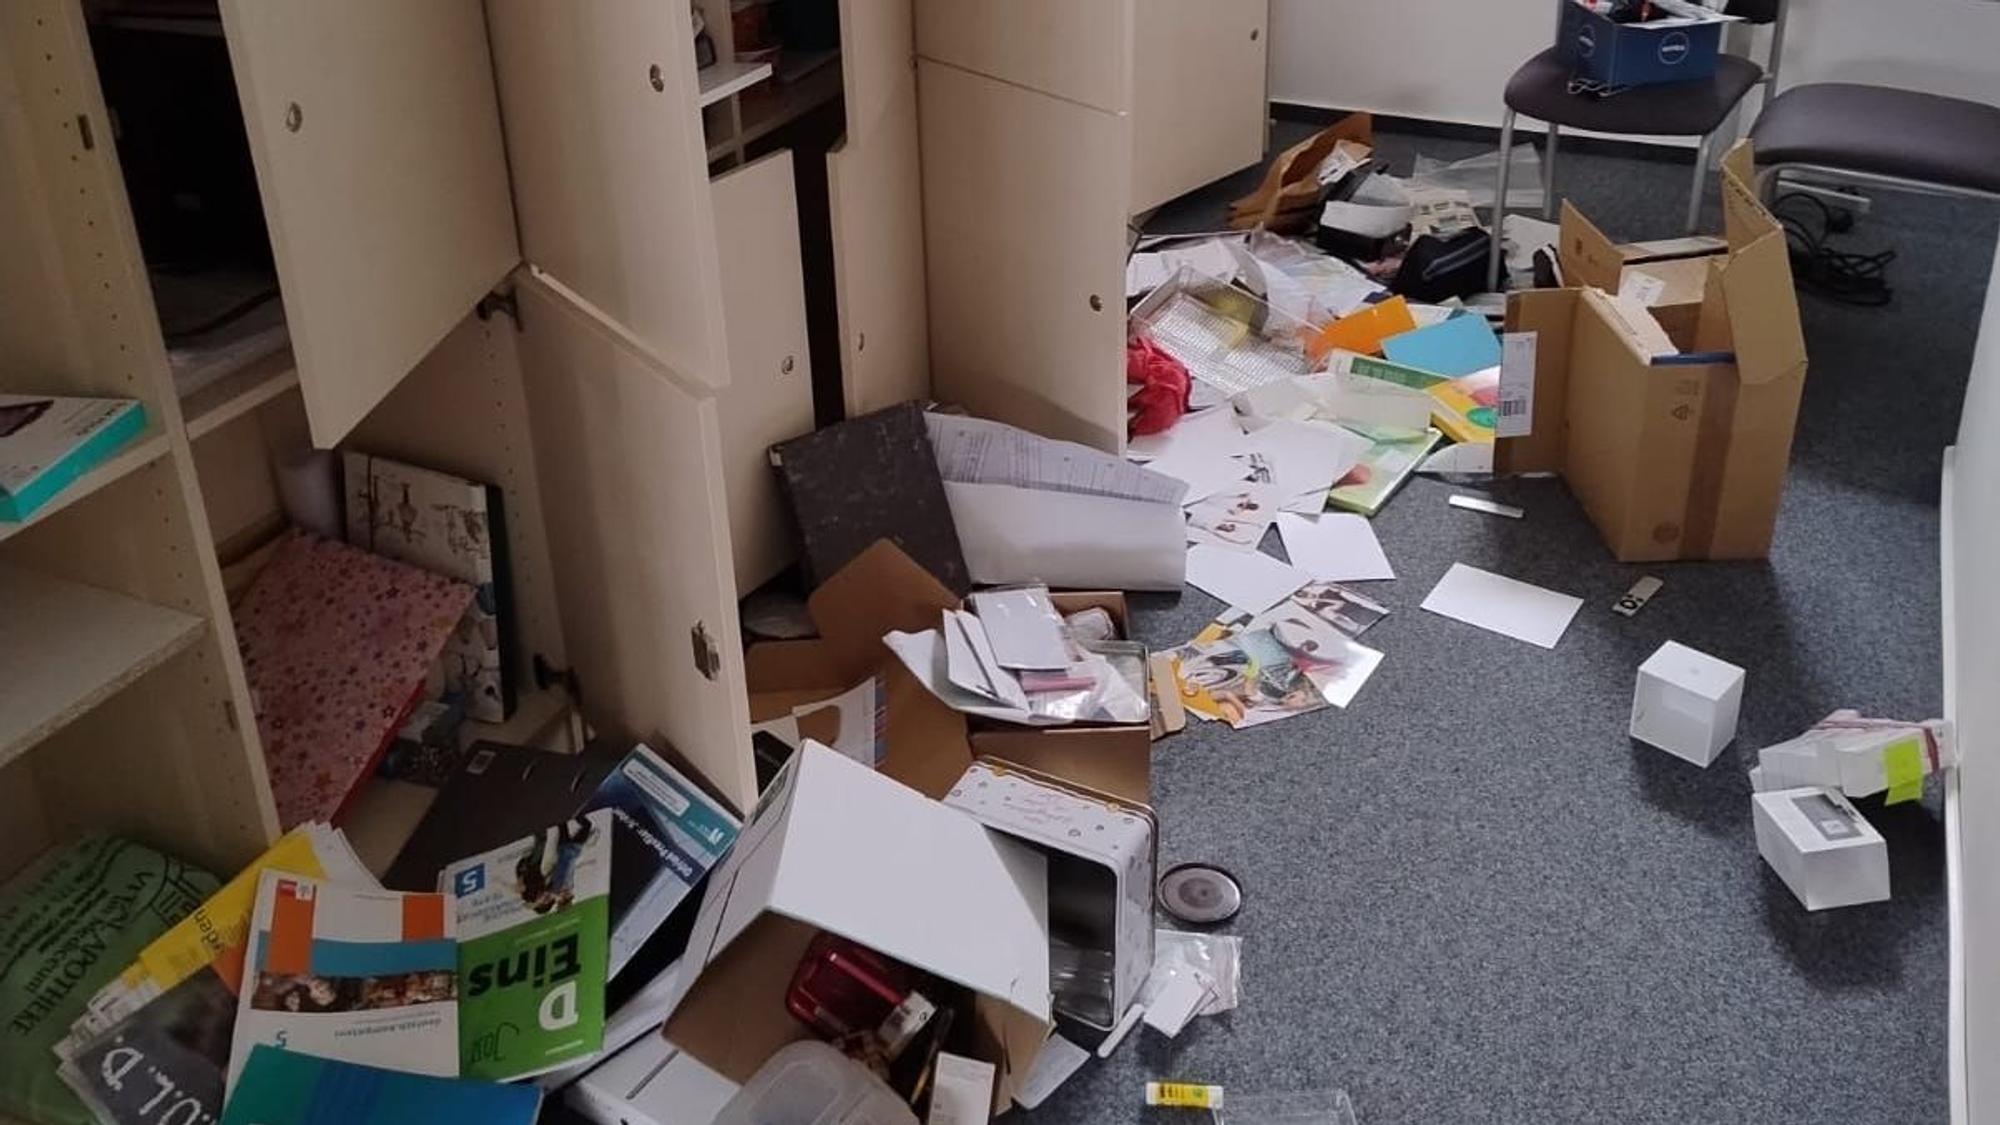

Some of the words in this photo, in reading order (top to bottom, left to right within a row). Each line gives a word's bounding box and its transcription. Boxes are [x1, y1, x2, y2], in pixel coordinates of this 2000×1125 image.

[463, 870, 478, 897] 5
[11, 926, 107, 1036] APOTHEKE
[468, 933, 582, 997] Eins
[538, 979, 579, 1031] D
